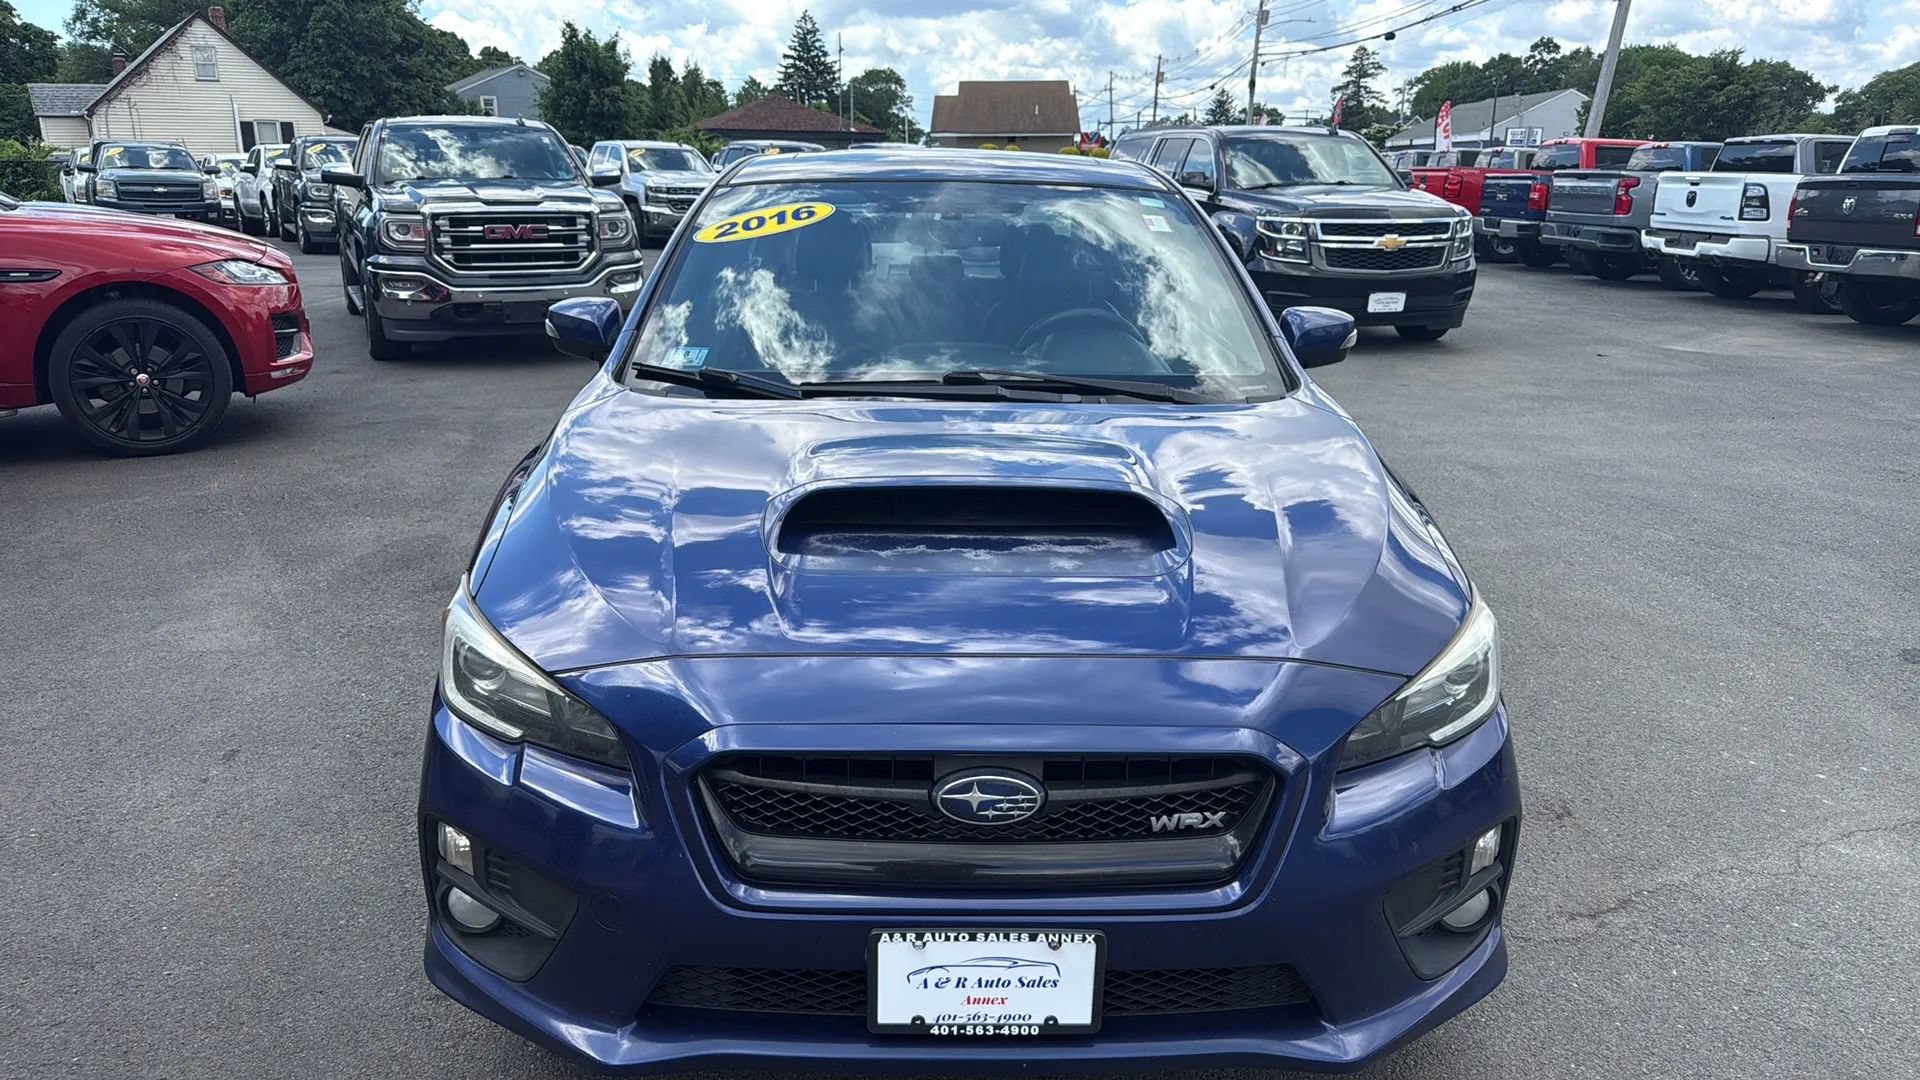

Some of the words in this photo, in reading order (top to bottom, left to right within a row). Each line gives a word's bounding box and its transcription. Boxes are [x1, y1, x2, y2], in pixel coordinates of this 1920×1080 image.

[713, 205, 817, 240] 2016
[484, 224, 548, 239] GMC
[1150, 811, 1226, 833] WRX
[879, 932, 918, 943] A&R
[922, 932, 970, 943] AUTO
[976, 932, 1030, 943] SALES
[1036, 933, 1096, 944] ANNEX
[916, 976, 929, 990] A
[934, 977, 951, 989] &
[954, 976, 968, 989] R
[971, 976, 1012, 990] Auto
[1015, 975, 1060, 989] Sales
[960, 994, 1009, 1006] Annex
[932, 1012, 1032, 1024] 401-563-4900
[929, 1025, 1040, 1036] 401-563-4900
